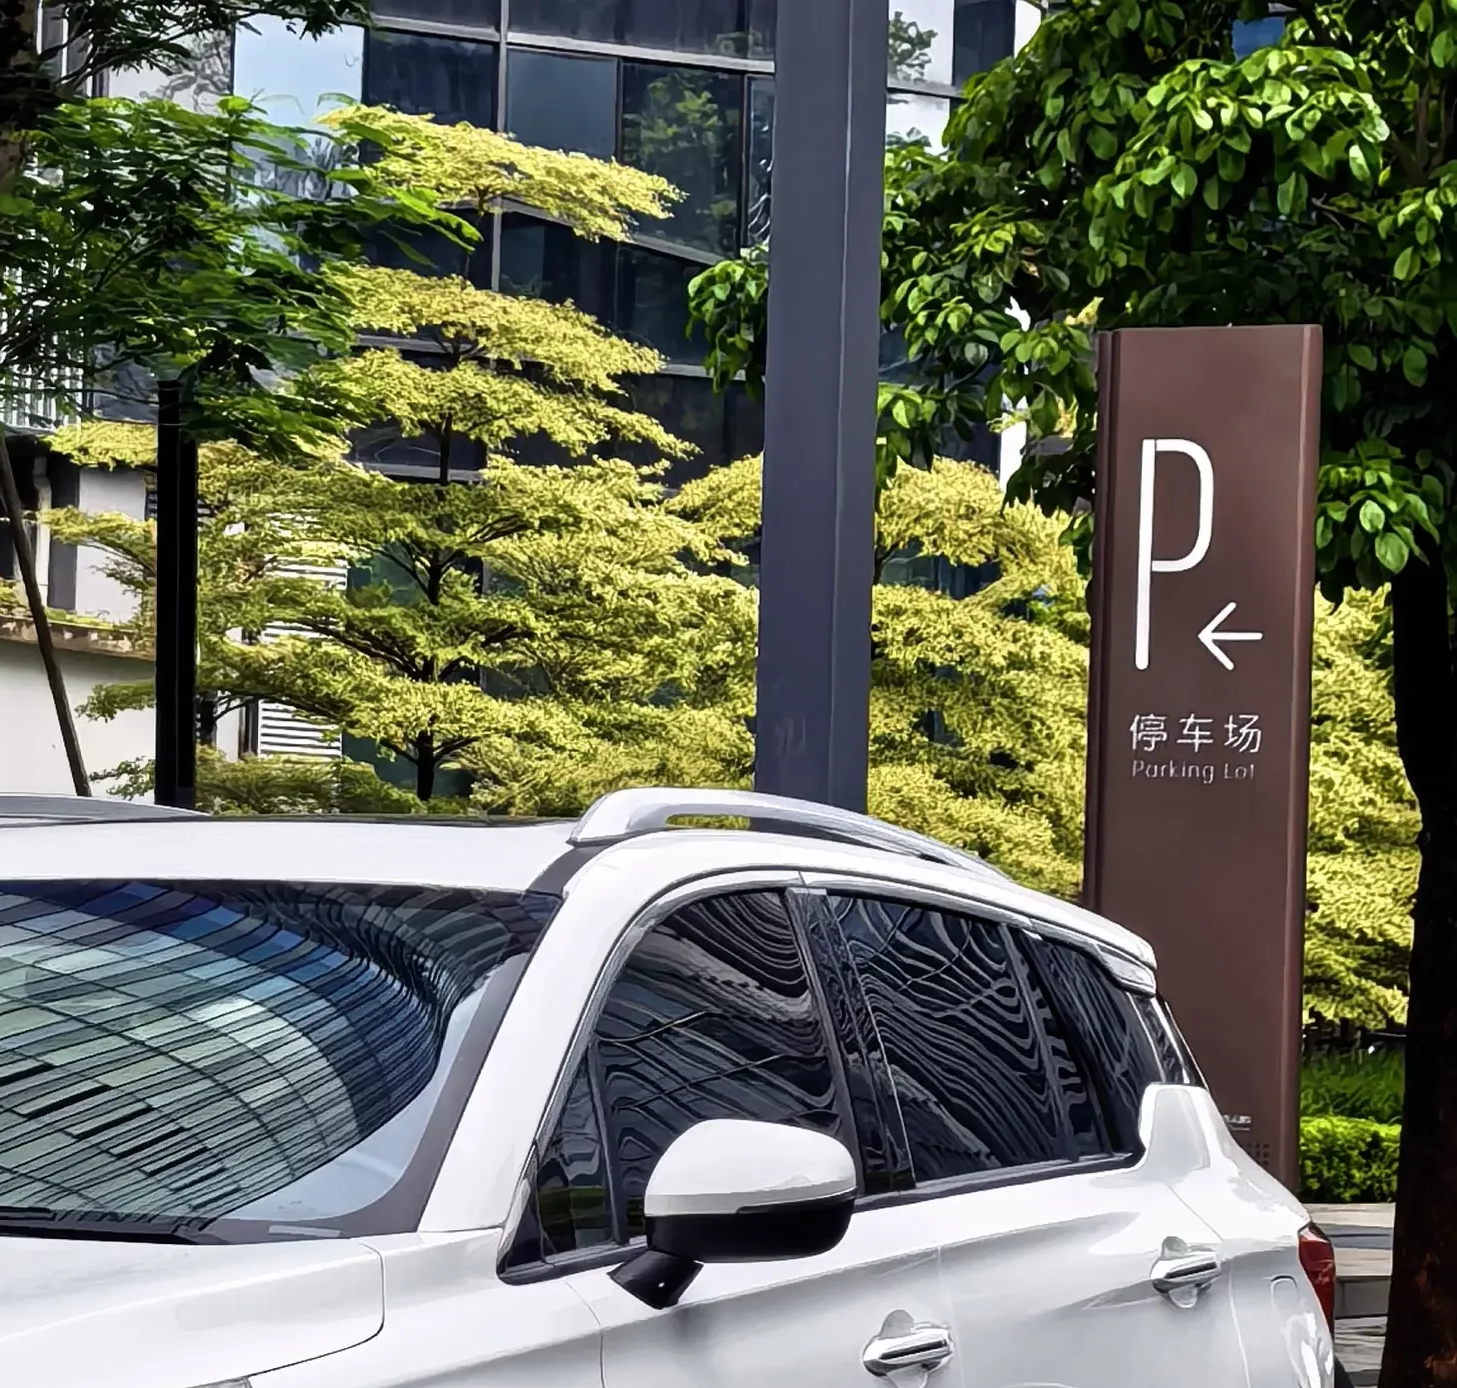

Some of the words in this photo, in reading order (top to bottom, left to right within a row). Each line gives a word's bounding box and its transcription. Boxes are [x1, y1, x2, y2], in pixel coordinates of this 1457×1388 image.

[1135, 438, 1214, 670] P
[1129, 713, 1262, 753] 停车场
[1132, 759, 1214, 784] Parking
